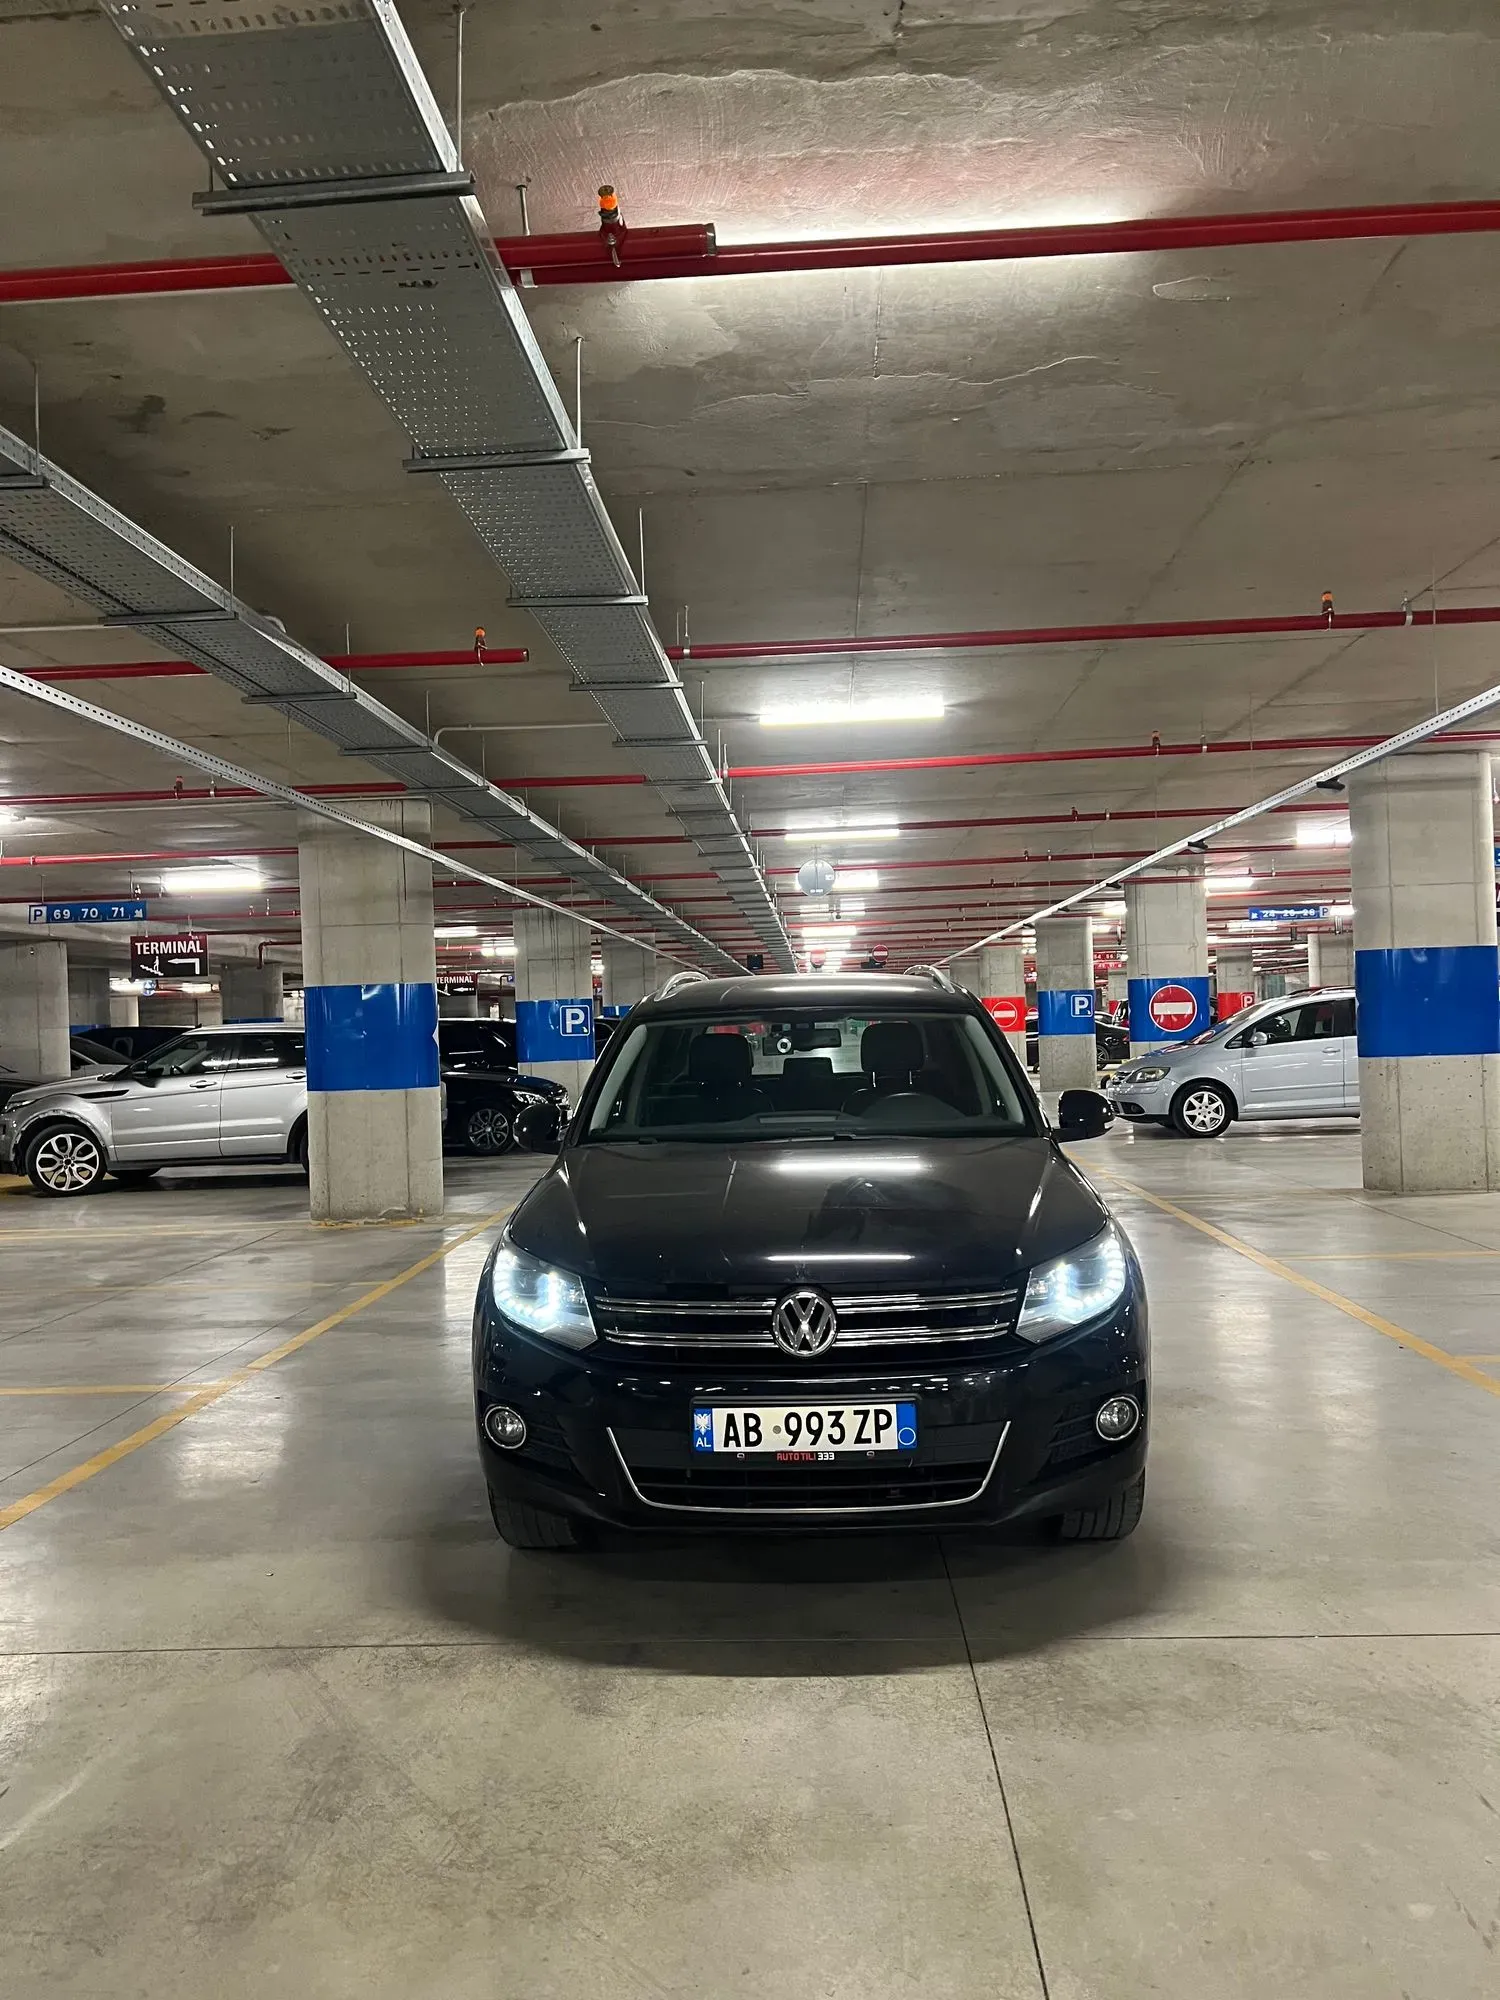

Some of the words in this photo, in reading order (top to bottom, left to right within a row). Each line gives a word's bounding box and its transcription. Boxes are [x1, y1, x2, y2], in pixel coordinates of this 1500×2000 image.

[33, 909, 43, 921] P
[53, 909, 71, 920] 69
[81, 908, 99, 918] 70
[111, 907, 125, 918] 71
[1321, 907, 1329, 918] P
[135, 940, 204, 955] TERMINAL
[436, 975, 474, 984] TERMINAL
[1074, 996, 1090, 1015] P
[1243, 995, 1253, 1008] P
[565, 1007, 586, 1034] P
[723, 1412, 763, 1448] AB
[784, 1410, 846, 1447] 993
[853, 1408, 893, 1445] ZP
[695, 1436, 712, 1447] AL
[776, 1452, 800, 1461] AUTO
[817, 1452, 835, 1461] 333
